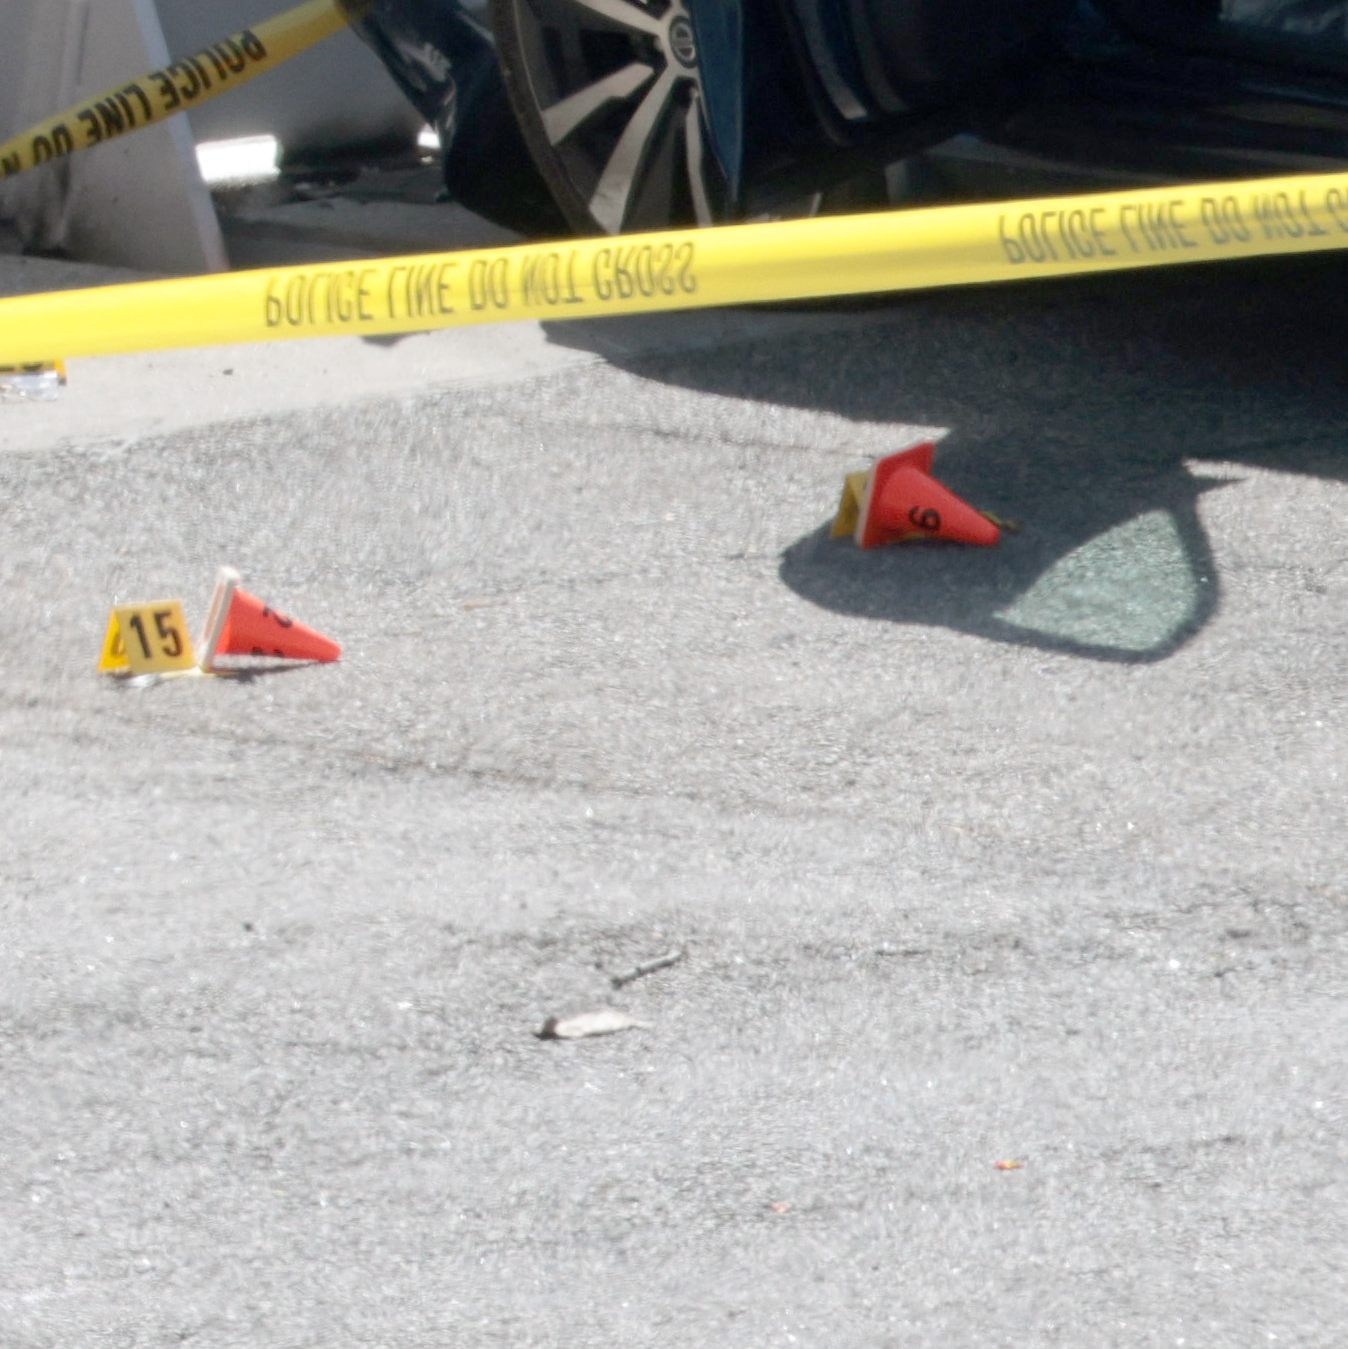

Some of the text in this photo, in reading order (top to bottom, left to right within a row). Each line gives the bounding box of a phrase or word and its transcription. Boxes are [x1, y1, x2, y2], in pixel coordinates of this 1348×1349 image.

[148, 29, 268, 110] POLICE
[77, 83, 153, 148] LINE
[129, 610, 184, 660] 15
